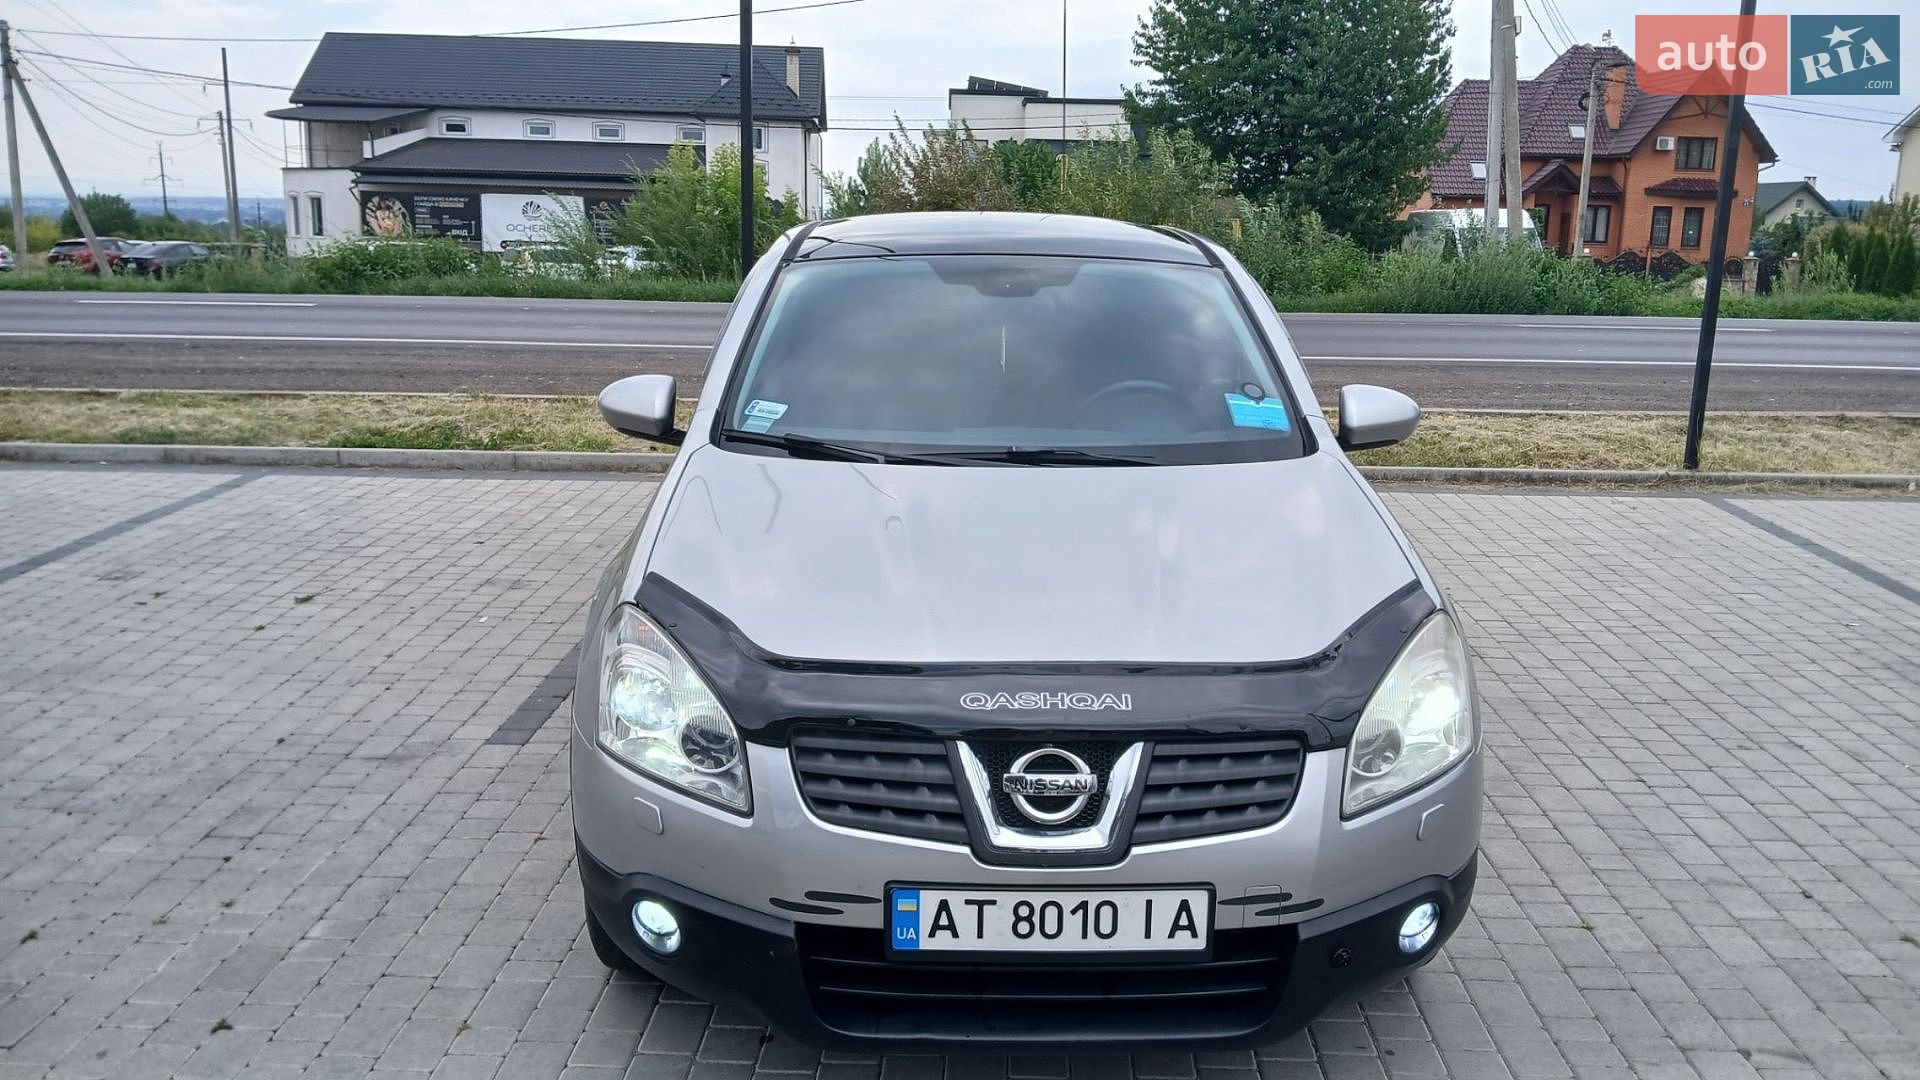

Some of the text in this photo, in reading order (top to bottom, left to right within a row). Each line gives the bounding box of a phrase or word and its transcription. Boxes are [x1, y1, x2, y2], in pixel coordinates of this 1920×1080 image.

[506, 223, 553, 233] OCHERE
[960, 692, 1132, 711] QASHQAI
[1014, 777, 1088, 791] NISSAN
[928, 899, 1199, 940] AT 8010 IA
[897, 927, 917, 941] UA
